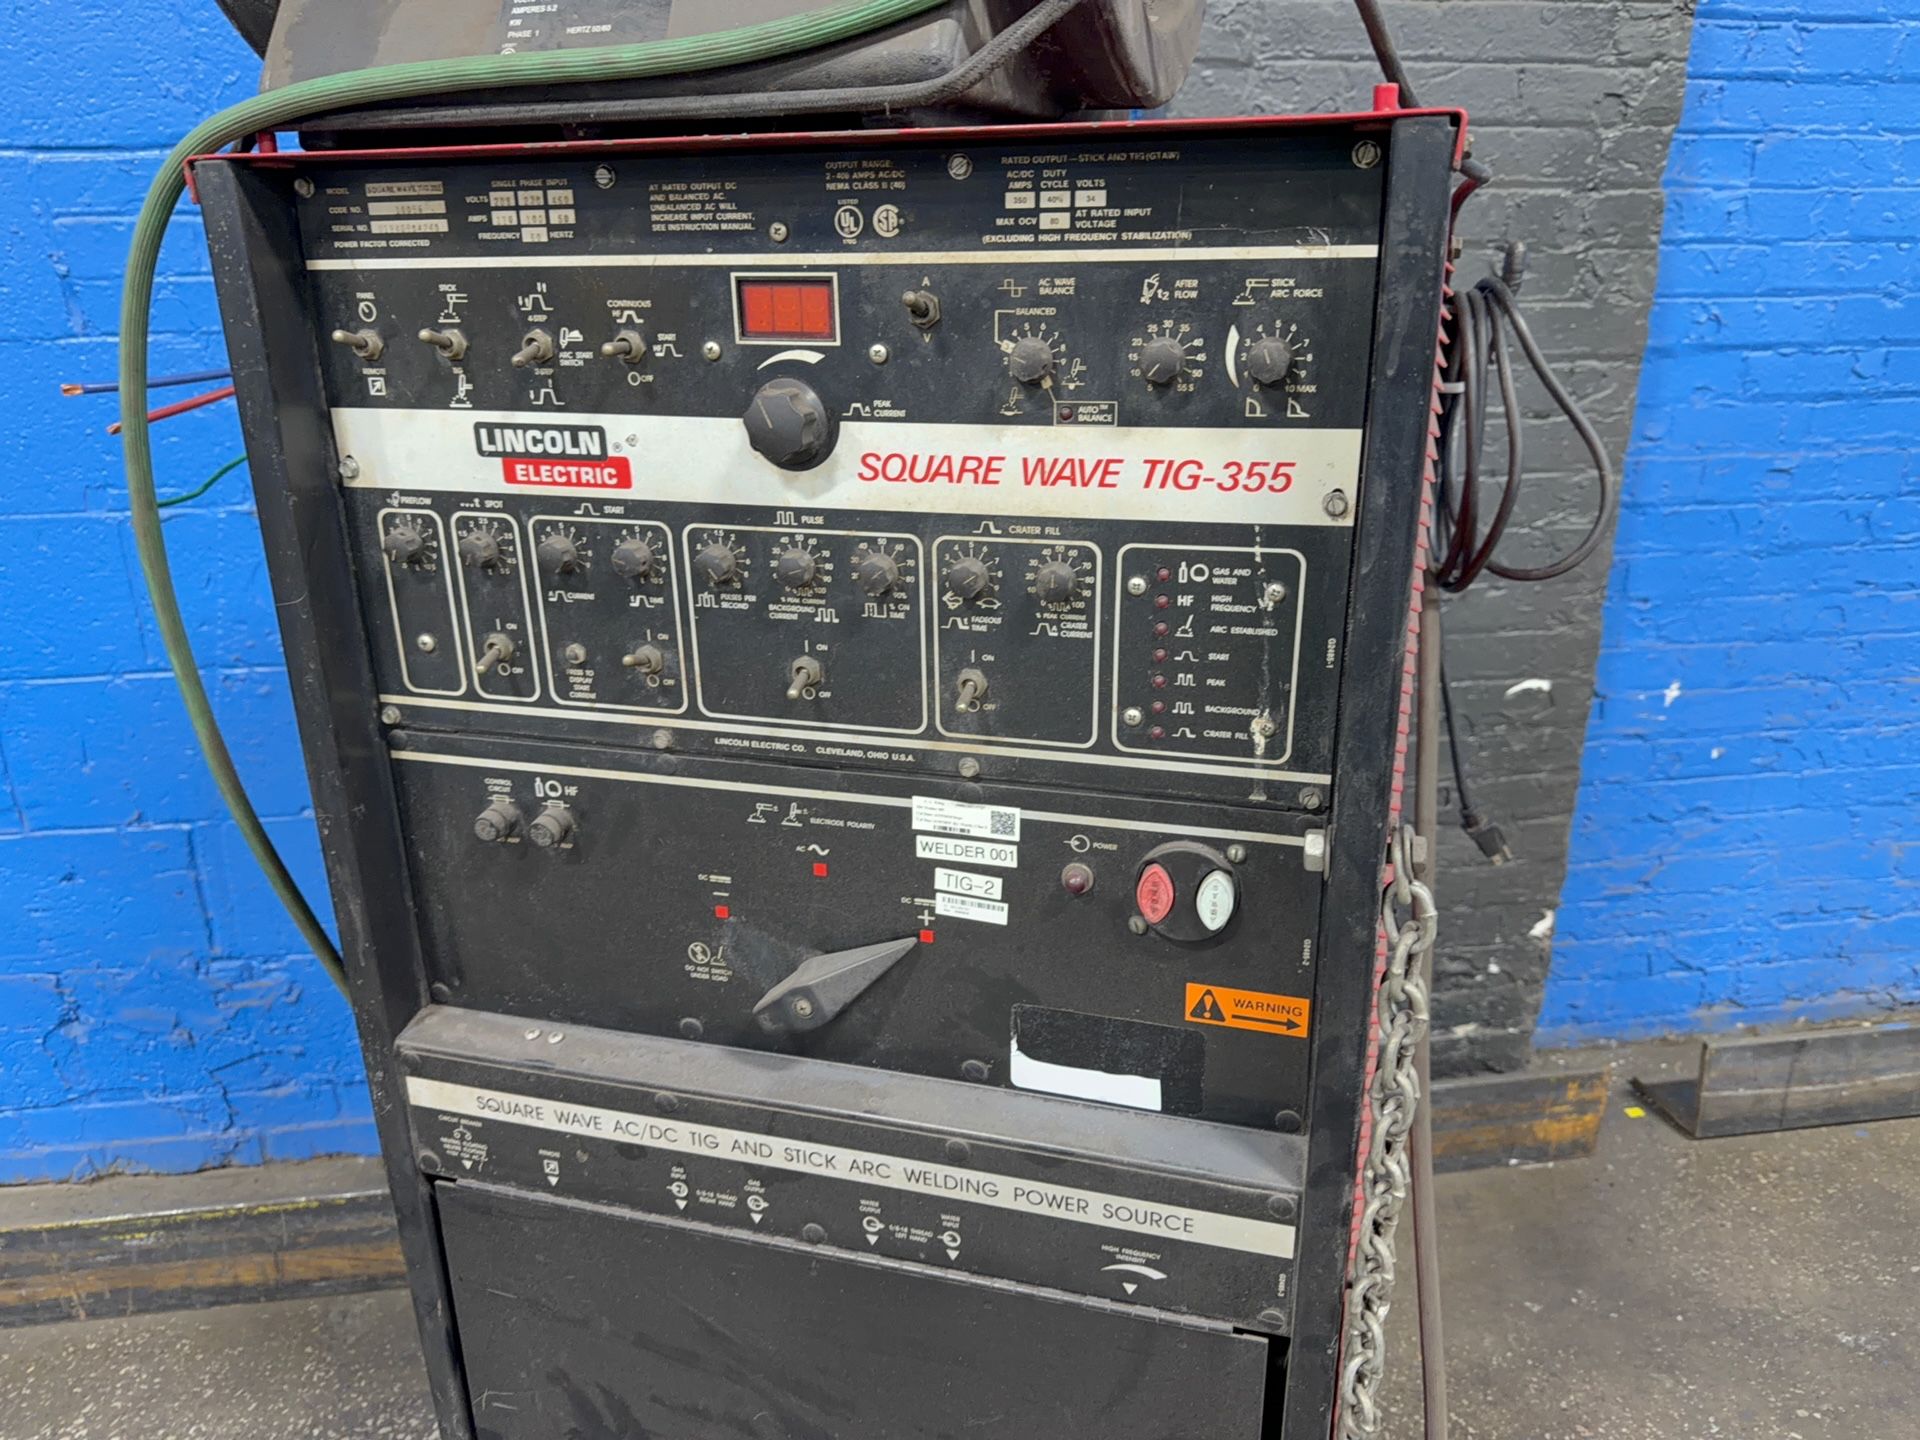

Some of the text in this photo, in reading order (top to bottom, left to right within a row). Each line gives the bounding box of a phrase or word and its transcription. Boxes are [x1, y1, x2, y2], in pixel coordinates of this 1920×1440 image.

[1001, 153, 1127, 164] RATED OUTPUT STICK AND
[825, 161, 858, 169] OUTPUT
[852, 170, 905, 179] AMPS AC/DC
[1006, 169, 1067, 178] AC/DC DUTY
[662, 183, 688, 191] RATED
[690, 182, 722, 190] OUTPUT
[725, 182, 737, 190] DC
[852, 182, 879, 190] CLASS
[1008, 179, 1106, 189] AMPS CYCLE VOLTS
[668, 193, 710, 201] BALANCED
[719, 202, 738, 210] WILL
[1075, 207, 1152, 217] AT RATED INPUT
[651, 213, 689, 221] INCREASE
[690, 213, 714, 221] INPUT
[995, 217, 1038, 226] MAX OCV
[652, 223, 666, 231] SEE
[668, 223, 720, 231] INSTRUCTION
[1075, 220, 1117, 228] VOLTAGE
[982, 234, 1035, 244] (EXCLUDING
[1038, 234, 1061, 242] HIGH
[1064, 232, 1118, 242] FREQUENCY
[921, 276, 931, 287] A
[1038, 277, 1076, 286] AC WAVE
[1174, 279, 1199, 288] AFTER
[1271, 278, 1296, 287] STICK
[1039, 286, 1075, 295] BALANCE
[1174, 290, 1199, 299] FLOW
[1270, 288, 1324, 298] ARC FORCE
[607, 299, 652, 308] CONTINUOUS
[1015, 307, 1057, 316] BALANCED
[1162, 319, 1174, 328] 30
[1179, 323, 1191, 332] 35
[1147, 324, 1158, 333] 25
[922, 333, 931, 343] V
[1131, 338, 1142, 346] 20
[1192, 338, 1204, 347] 40
[1128, 353, 1138, 361] 15
[1195, 353, 1207, 361] 45
[1130, 369, 1140, 377] 10
[1191, 369, 1203, 378] 50
[1295, 384, 1317, 393] MAX
[1077, 406, 1099, 414] AUTO
[1078, 413, 1112, 422] BALANCE
[478, 428, 602, 456] LINCOLN
[514, 464, 618, 485] ELECTRIC
[857, 452, 1297, 494] SQUARE WAVE TIG-355
[801, 515, 825, 525] PULSE
[1008, 525, 1061, 535] CRATER FILL
[1212, 567, 1252, 577] GAS AND
[1212, 577, 1238, 586] WATER
[1177, 594, 1195, 607] HF
[1211, 595, 1233, 603] HIGH
[898, 603, 910, 611] ON
[1210, 604, 1258, 613] FREQUENCY
[1210, 626, 1279, 636] ARC ESTABLISHED
[816, 643, 828, 651] ON
[1208, 653, 1230, 661] START
[1206, 678, 1226, 687] PEAK
[1204, 705, 1261, 716] BACKGROUND
[1203, 730, 1249, 740] CRATER FILL
[715, 737, 751, 748] LINCOLN
[751, 740, 790, 752] ELECTRIC
[867, 750, 889, 760] OHIO
[564, 785, 578, 796] HF
[809, 817, 845, 827] ELECTRODE
[919, 840, 1014, 862] WELDER 001
[1092, 842, 1118, 851] POWER
[943, 872, 995, 896] TIG-2
[1233, 998, 1303, 1017] WARNING
[476, 1096, 1196, 1235] SQUARE WAVE AC/DC TIG AND STICK ARC WELDING POWER SOURCE
[1101, 1244, 1162, 1260] HIGH FREQUENCY
